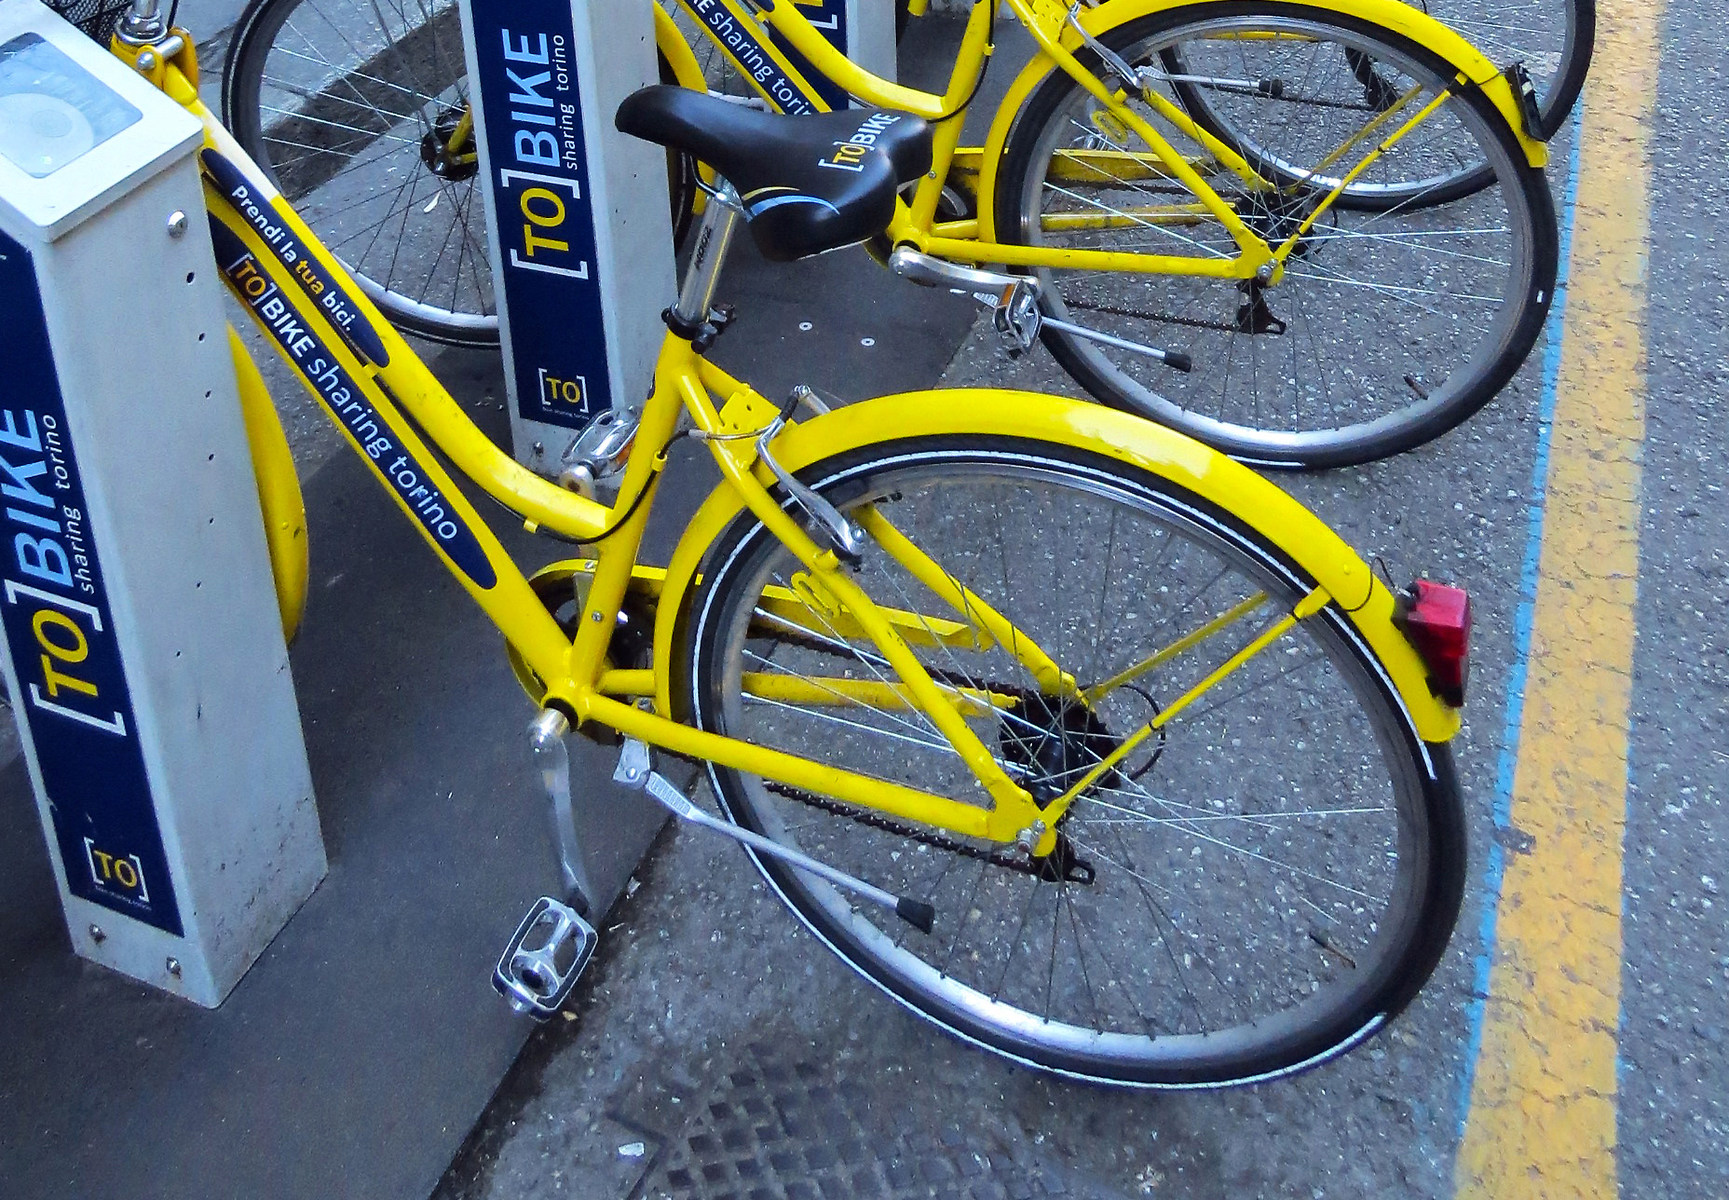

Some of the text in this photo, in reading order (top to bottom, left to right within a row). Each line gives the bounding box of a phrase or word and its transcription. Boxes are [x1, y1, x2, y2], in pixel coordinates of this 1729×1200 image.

[552, 34, 578, 171] sharing torino
[710, 11, 775, 82] sharing
[772, 77, 812, 115] tori
[501, 28, 589, 281] [TO]BIKE
[818, 112, 901, 173] [TO]BIKE
[232, 185, 356, 332] Prendi la tua bici.
[225, 252, 458, 539] [TO]BIKE sharing torino
[538, 367, 589, 413] [TO]
[0, 409, 127, 737] [TO]BIKE
[43, 414, 95, 595] sharing torino
[83, 836, 149, 903] [TO]
